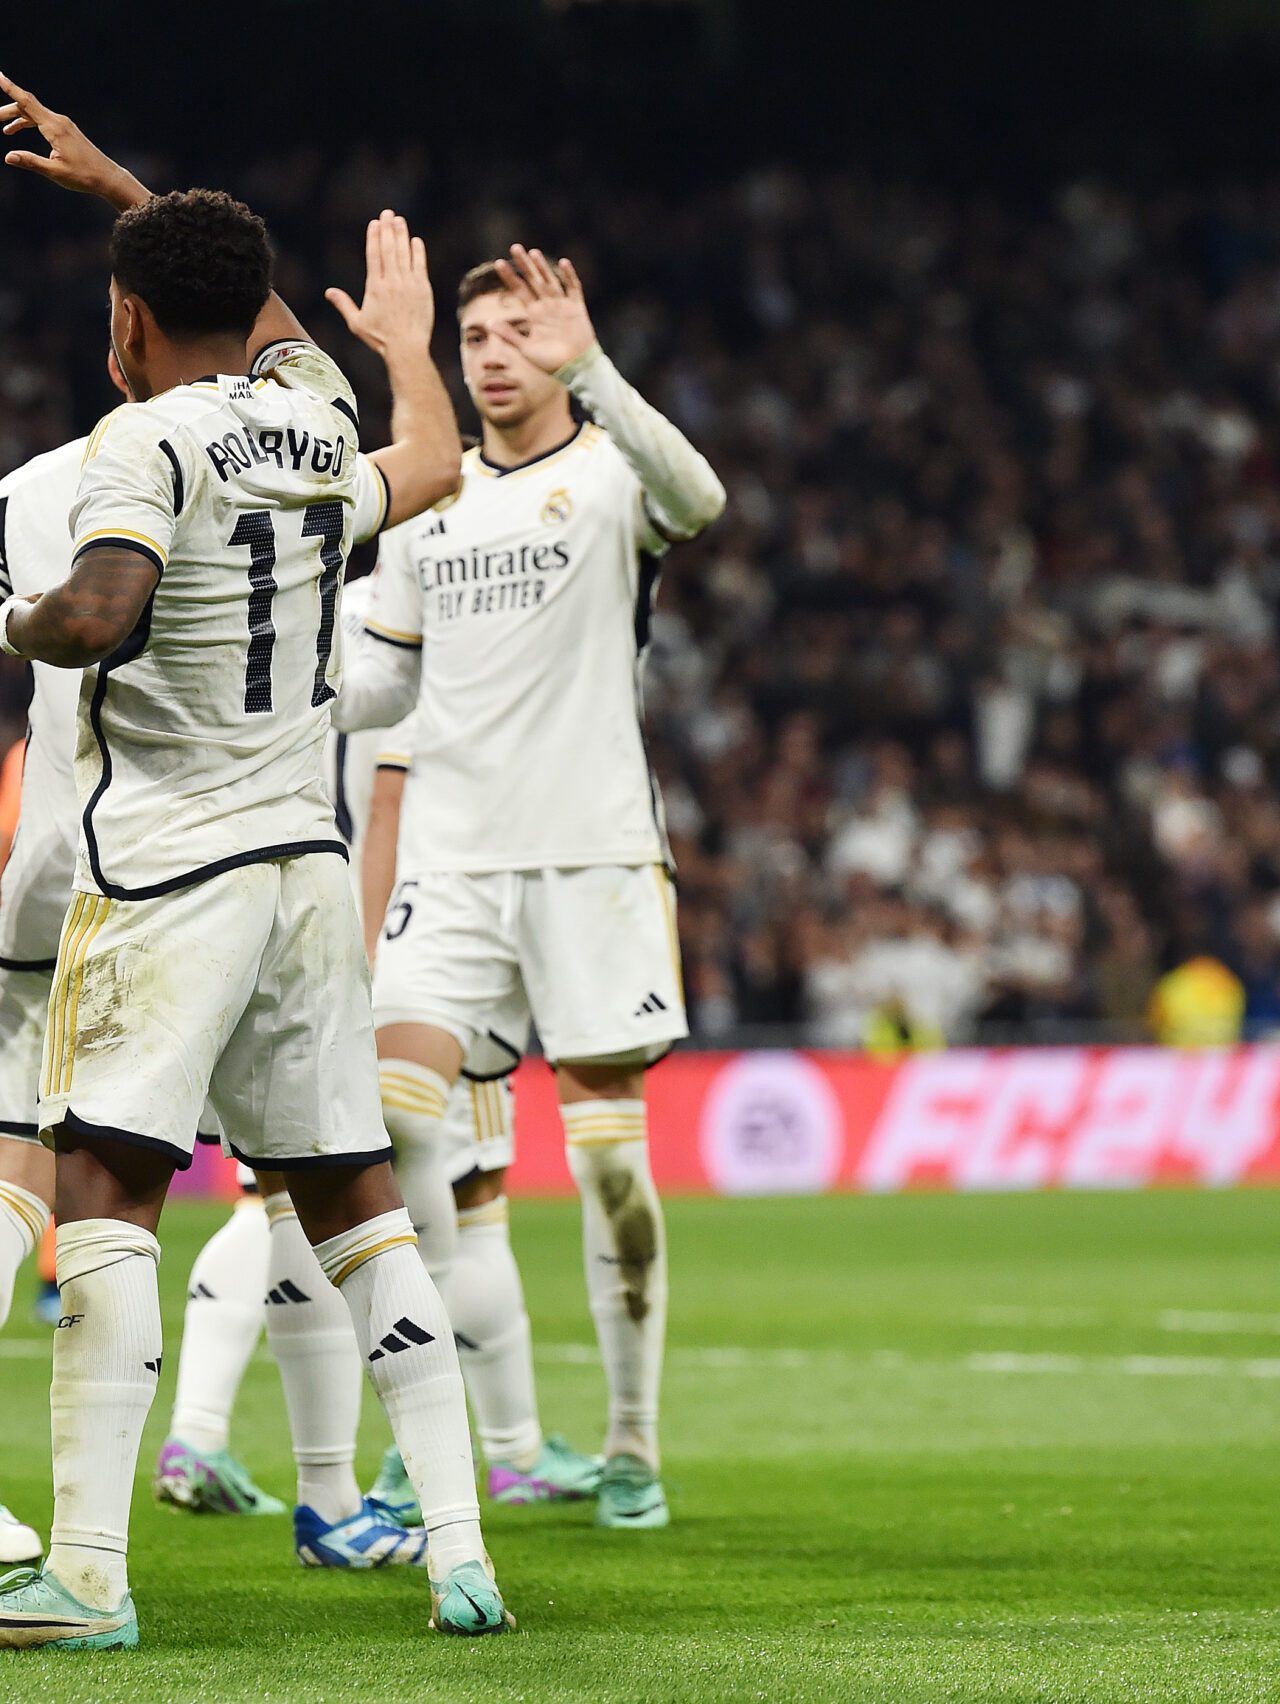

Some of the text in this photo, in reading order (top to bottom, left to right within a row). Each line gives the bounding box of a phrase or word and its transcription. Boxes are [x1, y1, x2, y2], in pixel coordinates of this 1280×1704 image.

[418, 541, 569, 592] Emirates
[226, 501, 344, 715] 11
[438, 579, 546, 622] FLY BETTER
[58, 1314, 85, 1328] CF
